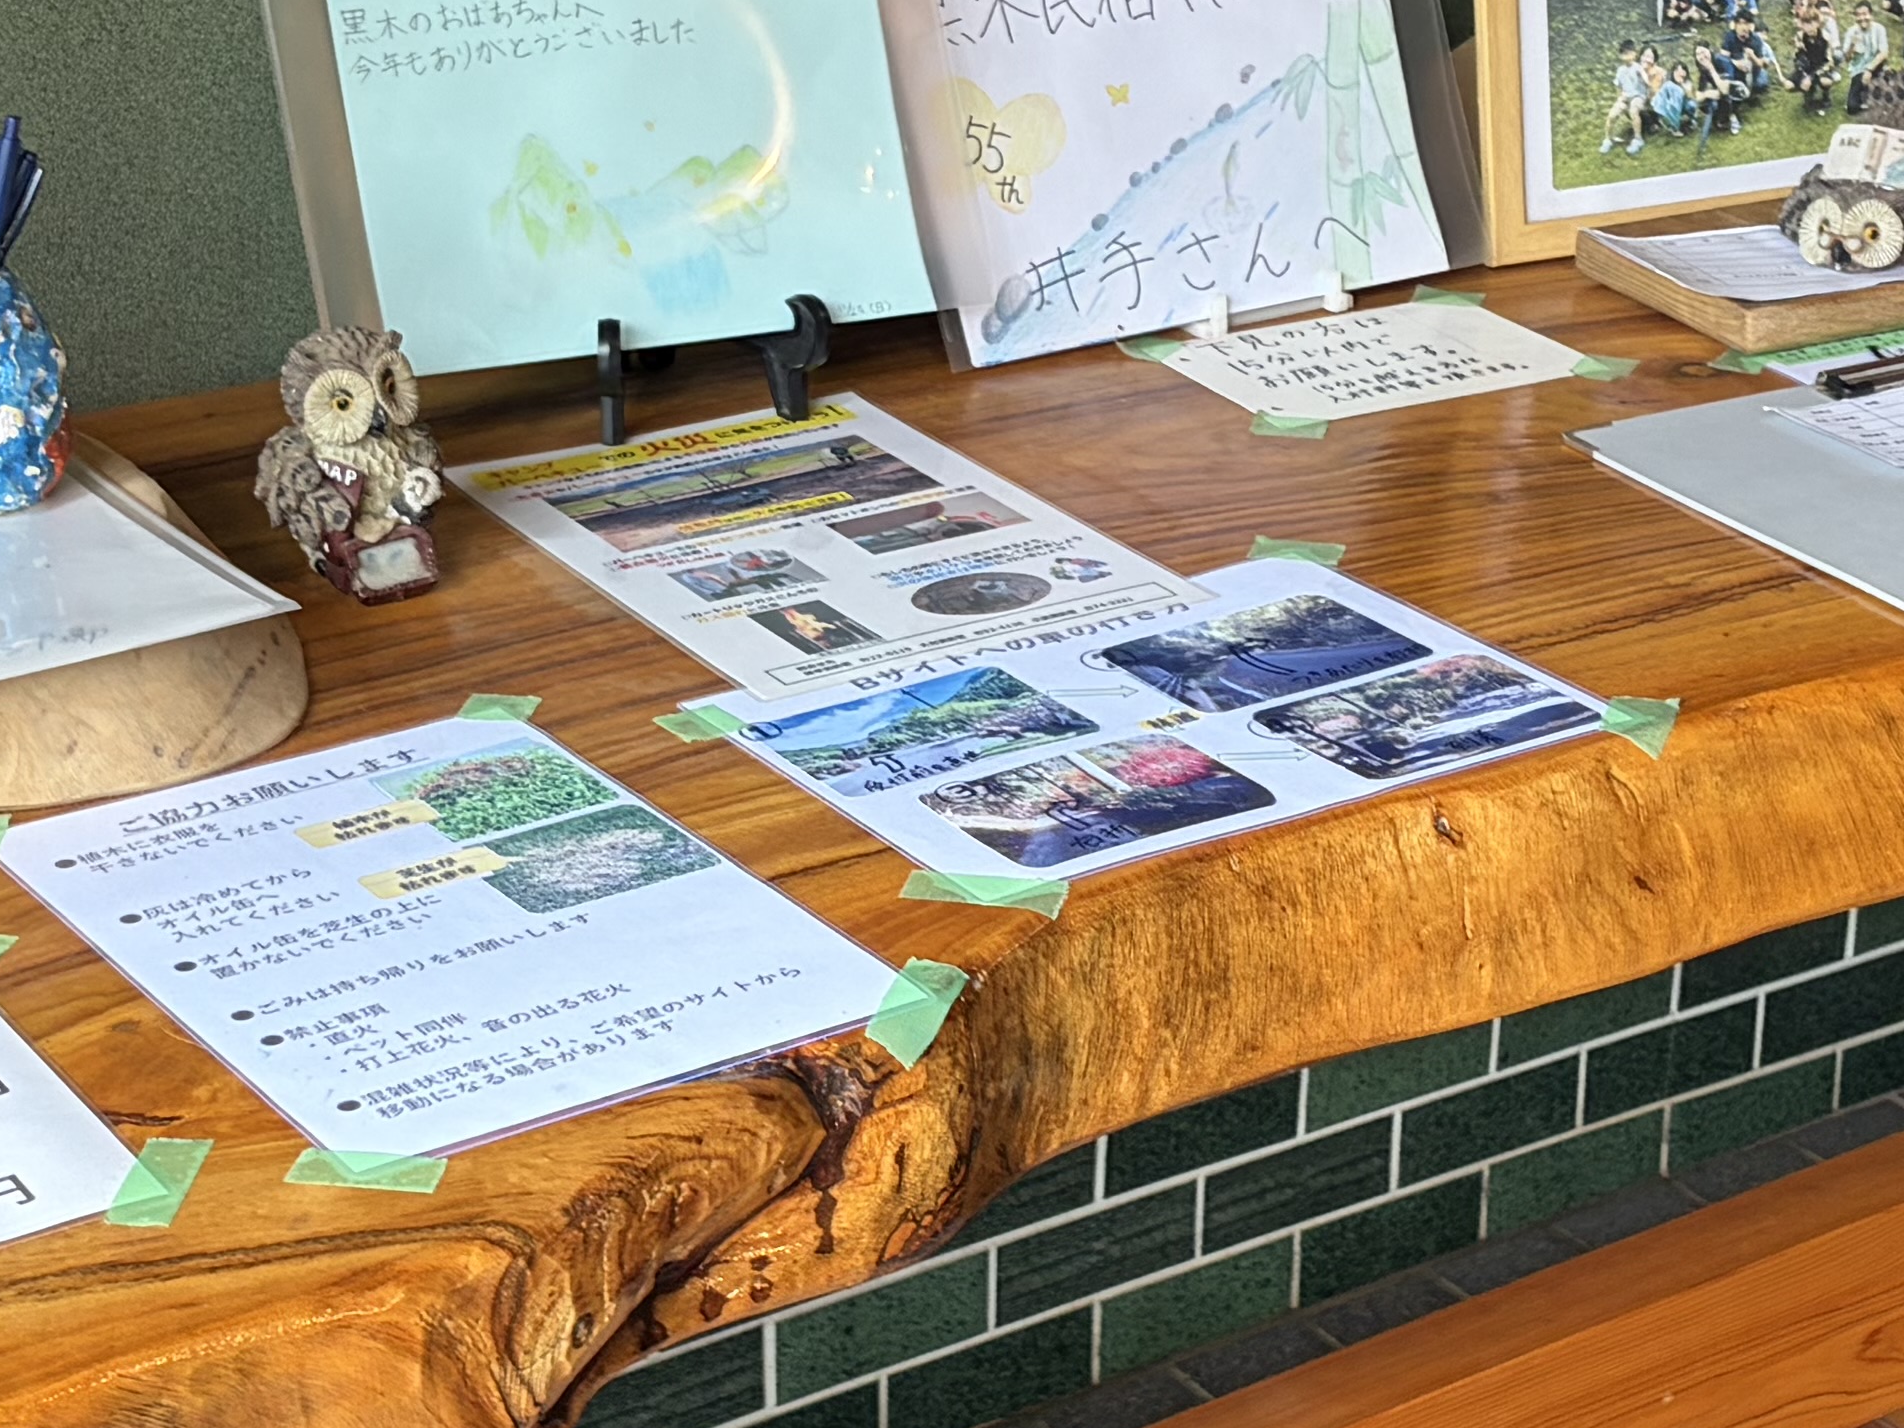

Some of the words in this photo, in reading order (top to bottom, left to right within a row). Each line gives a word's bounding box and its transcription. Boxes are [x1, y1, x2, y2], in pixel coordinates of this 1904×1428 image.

[349, 17, 696, 83] 今年もありがとうございました
[996, 175, 1023, 205] th
[1024, 218, 1370, 312] 井手さんへ
[118, 747, 419, 835] ご協力お願いします
[77, 822, 220, 866] 植木に衣服を
[89, 814, 303, 875] 干さないでください
[141, 866, 313, 921] 灰は冷めてから
[157, 891, 281, 933] オイル缶へ
[172, 888, 341, 944] 入れてください
[197, 893, 443, 968] オイル缶を芝生の上に
[210, 911, 433, 981] 置かないでください
[256, 912, 592, 1018] ごみは持ち帰りをお願いします
[283, 1002, 390, 1042] 禁止事項
[376, 1016, 676, 1121] 移動になる場合があります
